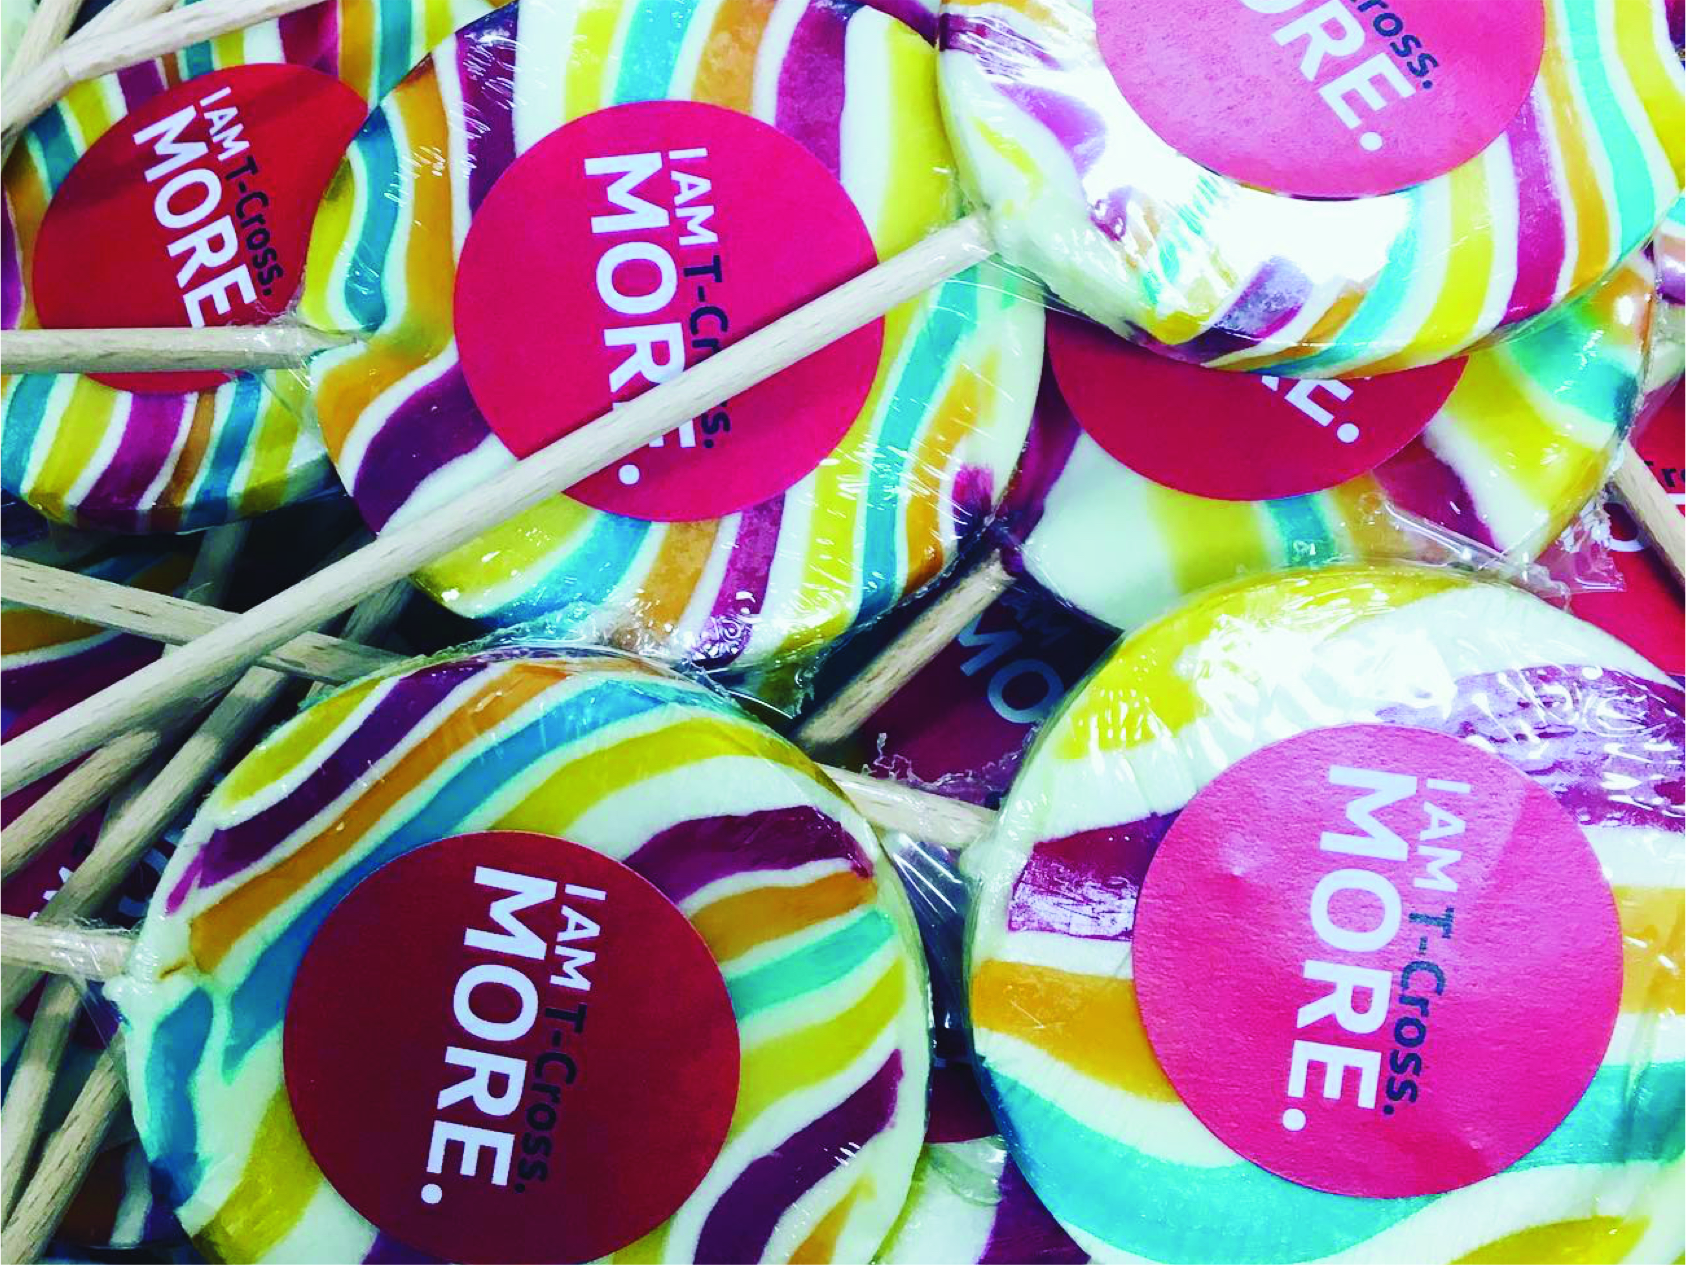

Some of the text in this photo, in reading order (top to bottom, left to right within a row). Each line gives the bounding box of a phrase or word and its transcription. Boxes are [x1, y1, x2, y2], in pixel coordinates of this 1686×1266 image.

[200, 87, 284, 296] I AM T-Cross.
[1240, 0, 1417, 151] RE.
[1349, 0, 1439, 89] ross.
[584, 152, 696, 485] MOR.
[669, 148, 731, 449] I AM T-Crs.
[421, 865, 557, 1204] MORE.
[514, 884, 607, 1194] I AM T-Cross.
[1282, 764, 1418, 1132] MORE.
[1383, 778, 1472, 1116] I AM T-Cross.
